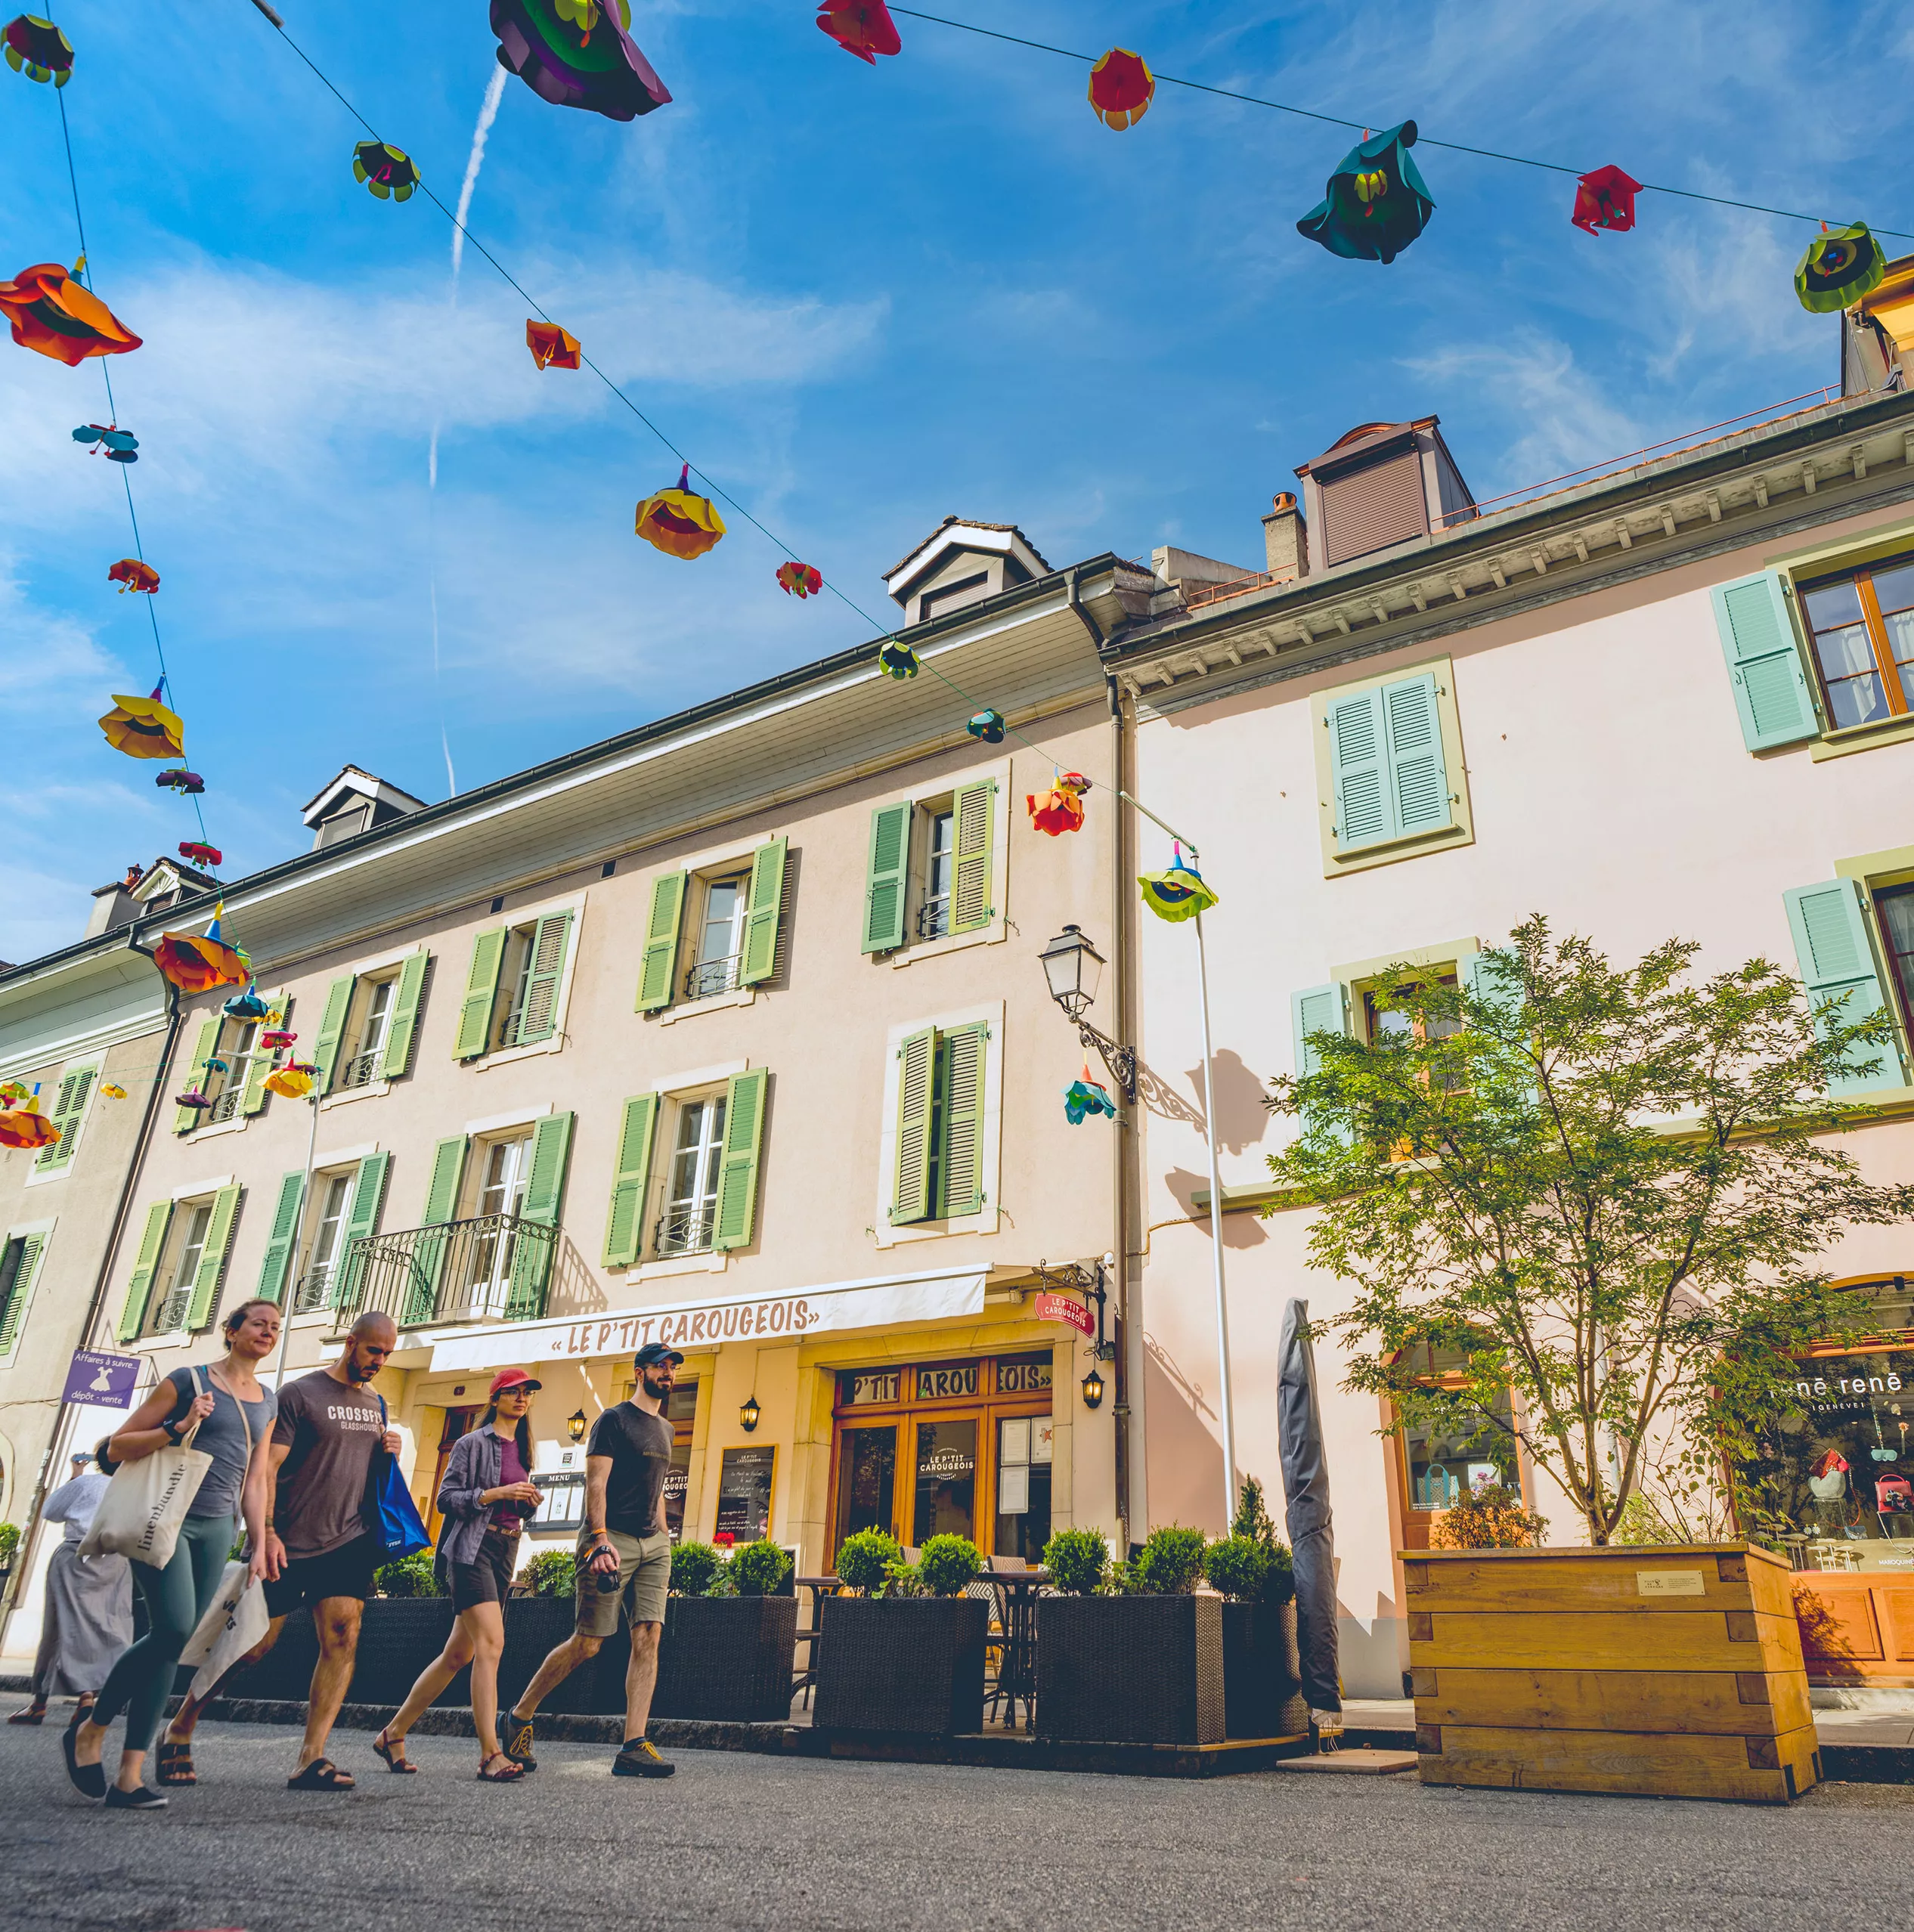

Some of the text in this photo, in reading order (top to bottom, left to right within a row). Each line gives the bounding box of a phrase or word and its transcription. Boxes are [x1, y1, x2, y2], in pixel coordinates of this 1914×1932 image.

[1051, 1297, 1079, 1314] LE P'TIT
[1045, 1306, 1086, 1327] CAROUGEOIS
[568, 1325, 593, 1354] LE
[596, 1317, 655, 1351] P'TIT
[74, 1353, 104, 1364] Affaires
[105, 1357, 111, 1366] à
[1839, 1372, 1902, 1395] renē
[71, 1390, 94, 1401] dépôt
[101, 1395, 123, 1404] vente
[920, 1461, 974, 1472] CAROUGEOIS
[942, 1454, 964, 1463] P'TIT
[137, 1463, 187, 1552] linenbundle
